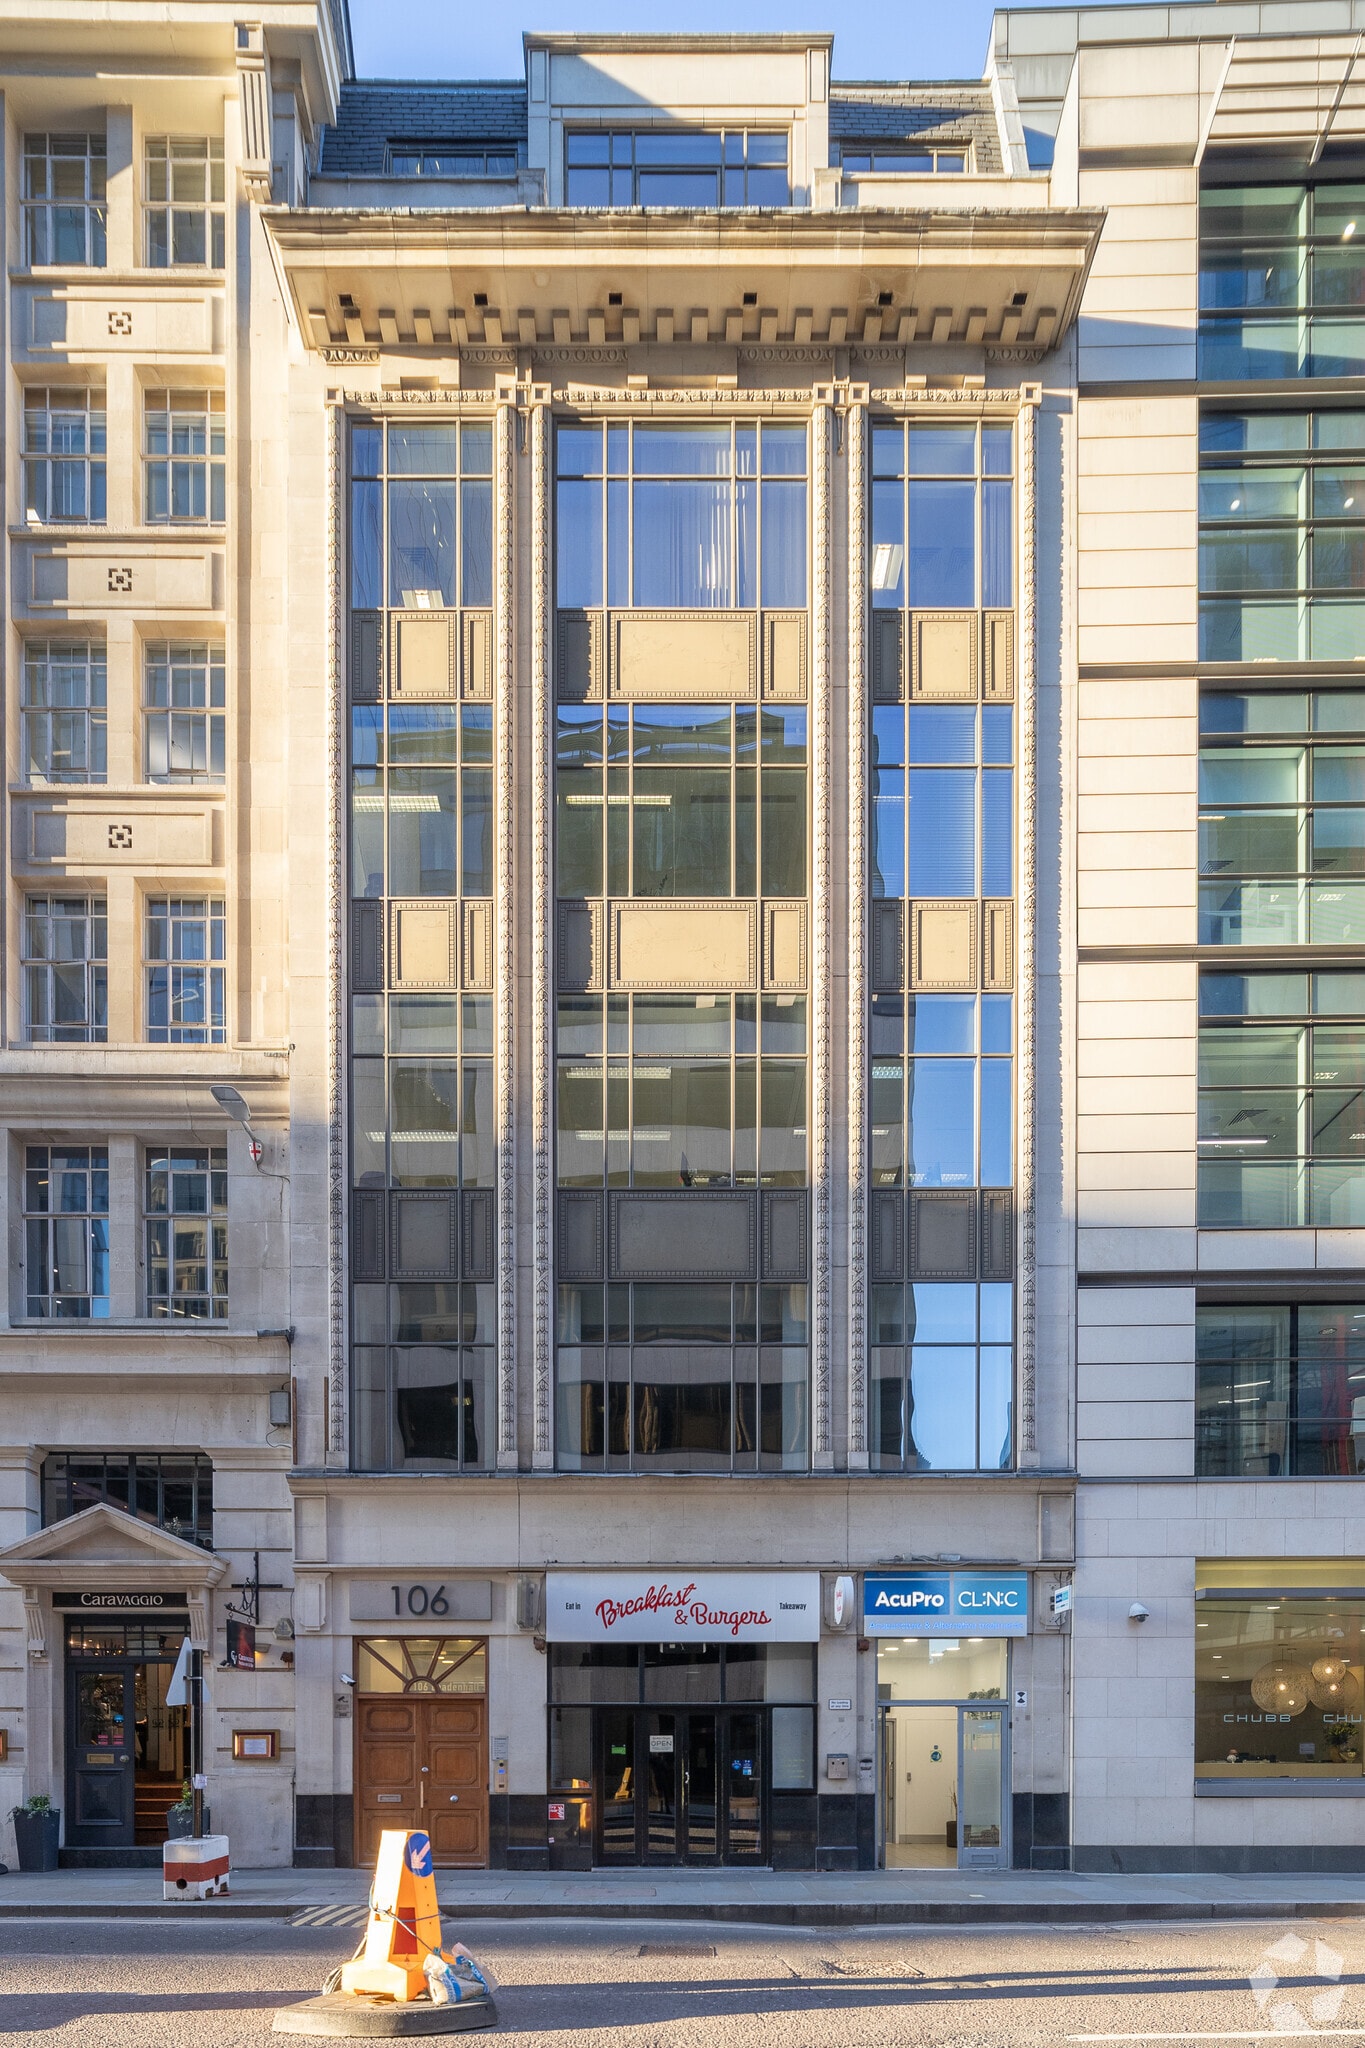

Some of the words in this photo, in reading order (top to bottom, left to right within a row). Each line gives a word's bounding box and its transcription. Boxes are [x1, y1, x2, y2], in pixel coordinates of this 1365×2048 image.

[391, 1585, 449, 1616] 106
[565, 1602, 575, 1610] Eat
[575, 1602, 581, 1610] in
[874, 1590, 945, 1608] AcuPro
[595, 1583, 697, 1630] Breakfast
[779, 1602, 807, 1611] Takeaway
[674, 1609, 689, 1626] &
[689, 1602, 772, 1636] Burgers
[414, 1682, 428, 1692] 106
[431, 1682, 480, 1692] Ladenhall
[1223, 1714, 1292, 1723] CHUBB
